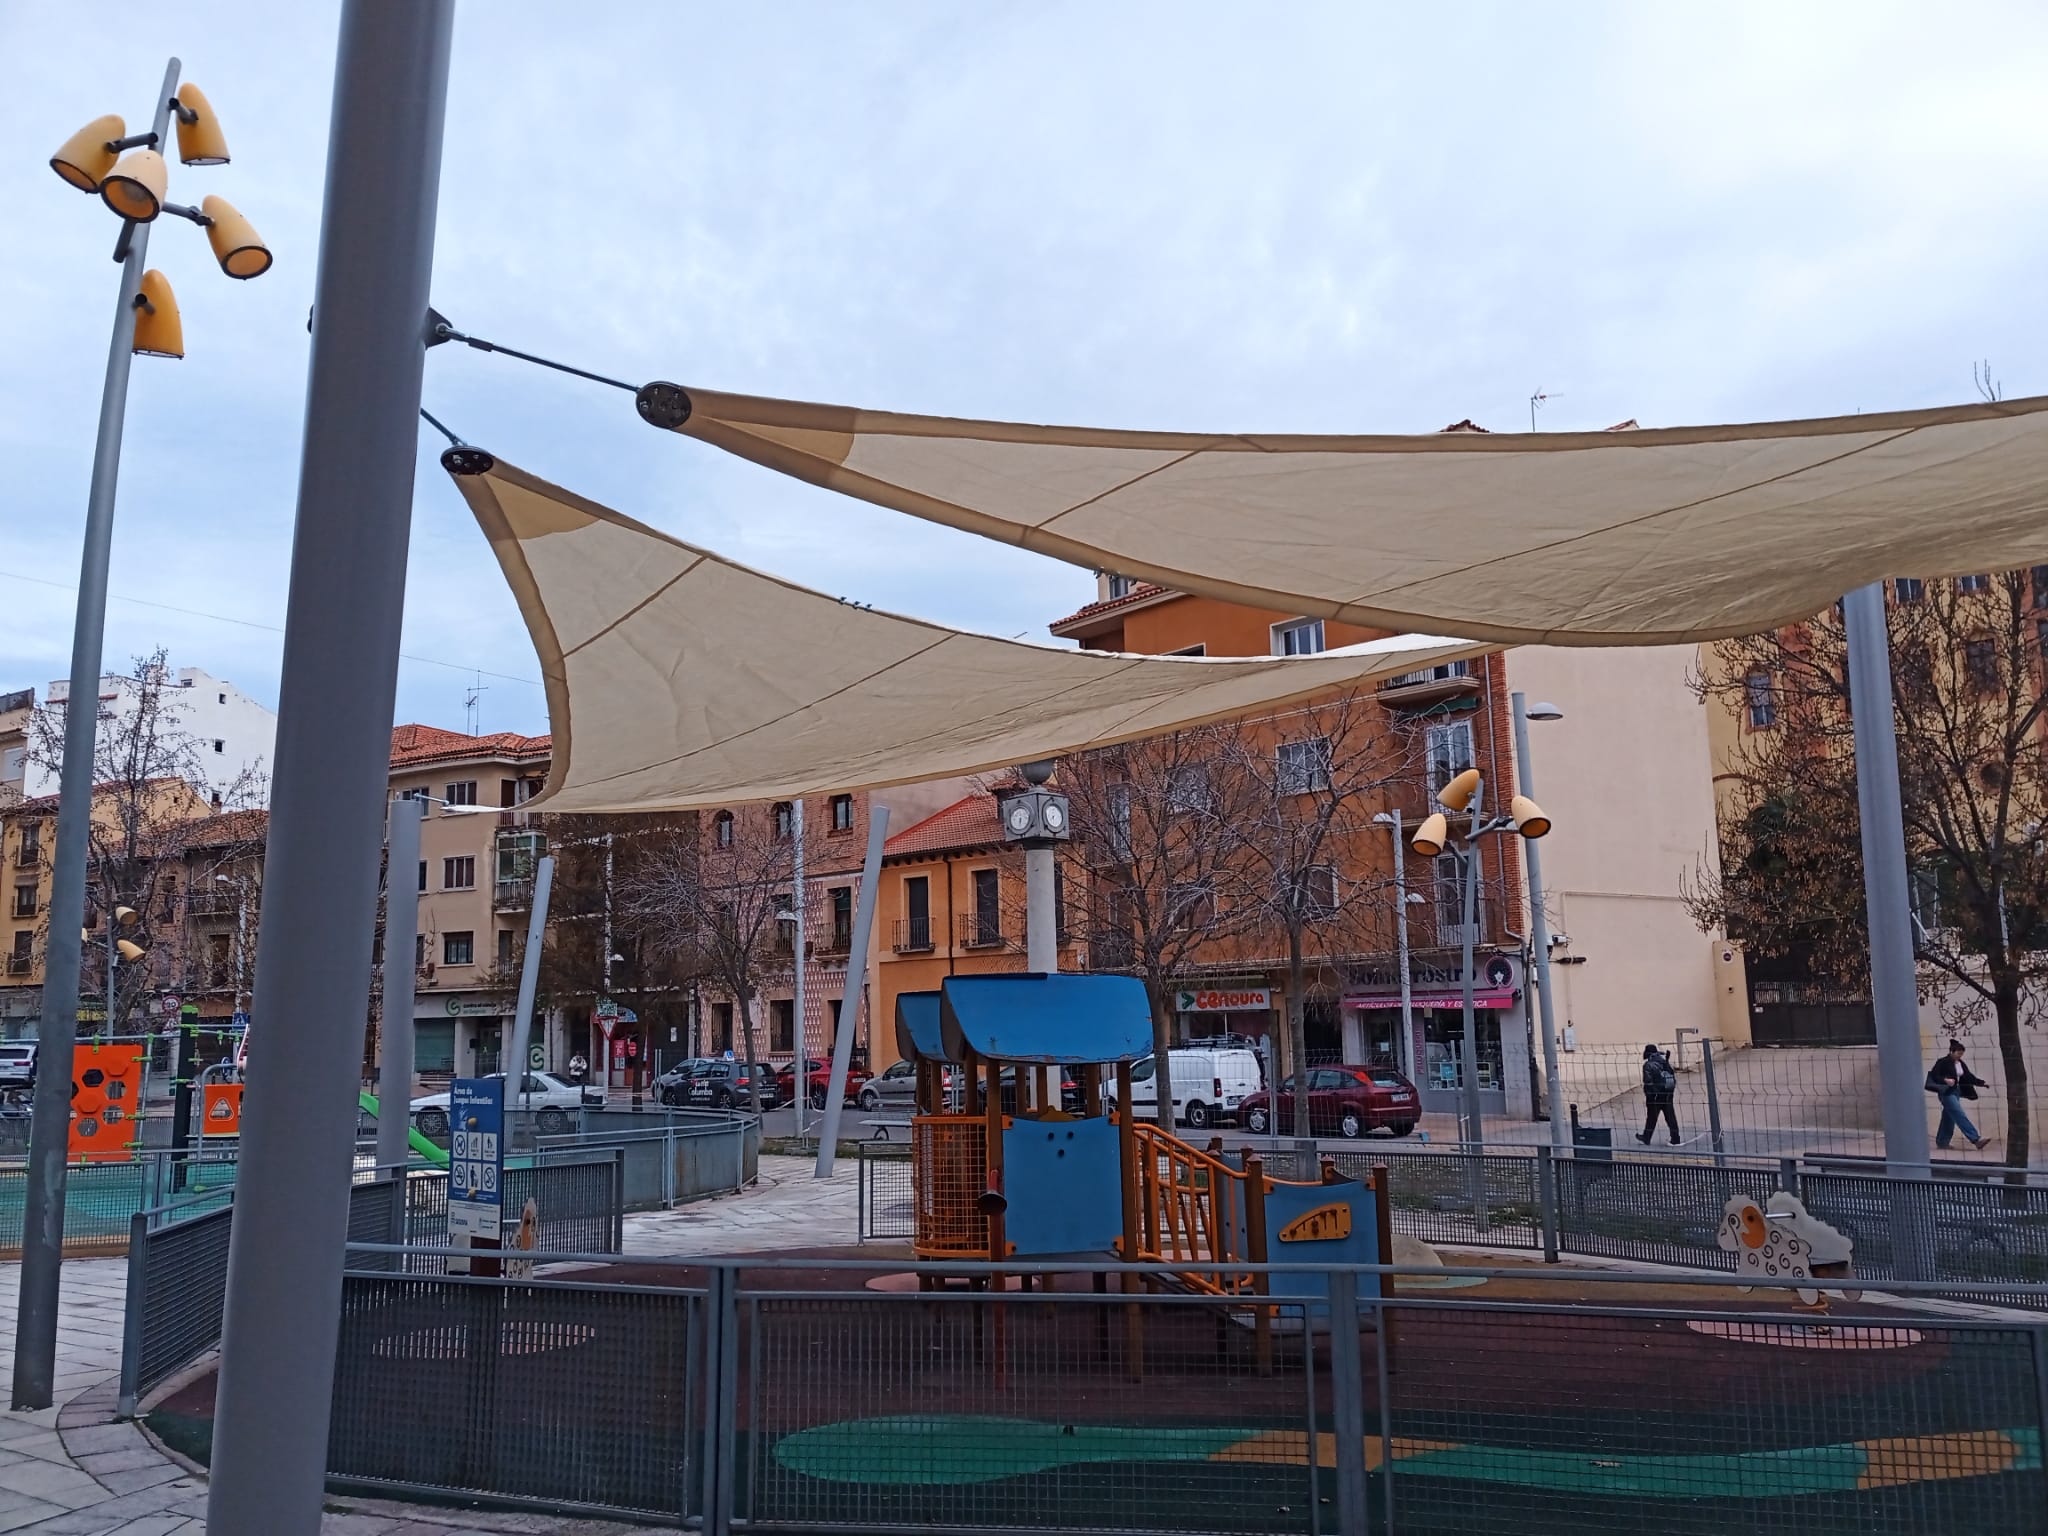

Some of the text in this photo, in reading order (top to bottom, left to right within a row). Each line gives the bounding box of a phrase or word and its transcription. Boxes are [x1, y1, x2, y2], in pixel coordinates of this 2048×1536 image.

[1453, 999, 1488, 1008] ESTICA
[453, 1084, 473, 1095] Área de
